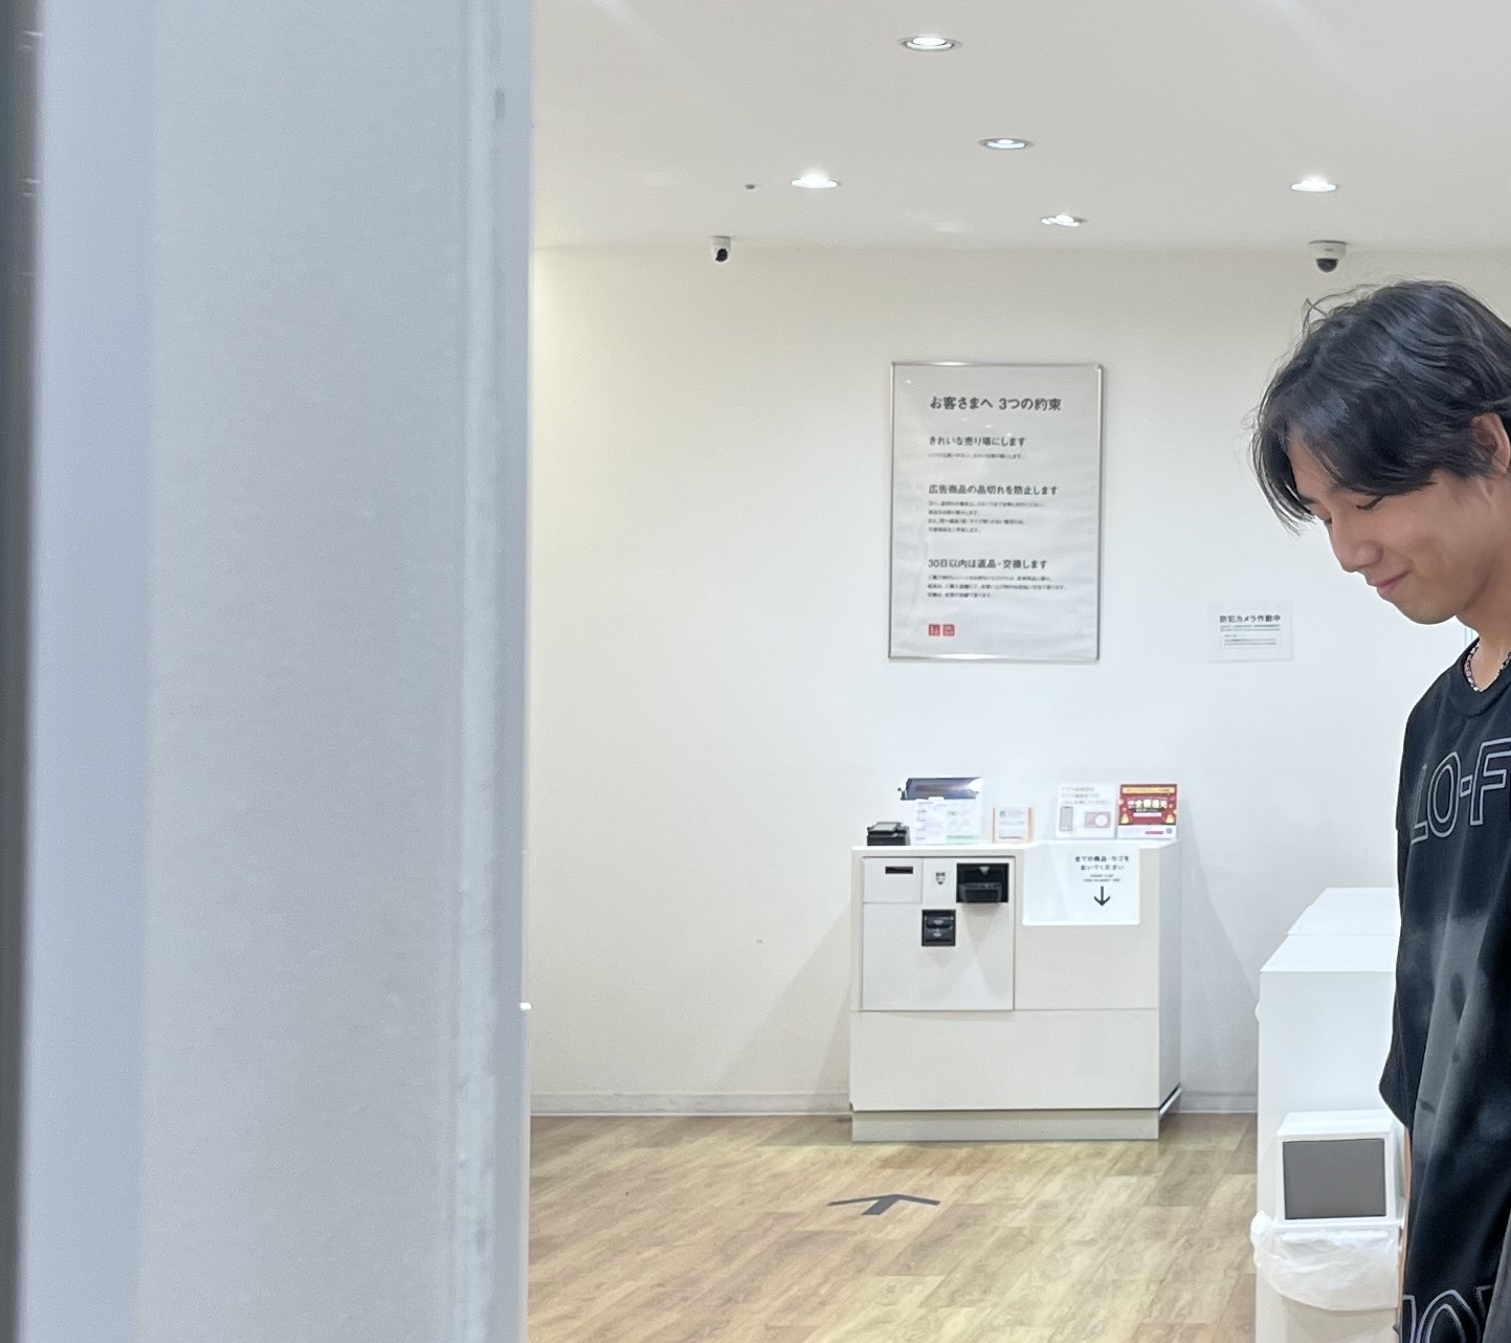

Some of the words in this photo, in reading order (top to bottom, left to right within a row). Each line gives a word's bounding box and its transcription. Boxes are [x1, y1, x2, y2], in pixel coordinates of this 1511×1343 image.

[929, 396, 993, 410] お客さまへ
[998, 397, 1061, 411] 3つの約束
[929, 436, 1026, 447] きれいな売り場にします
[928, 484, 1058, 495] 広告商品の品切れを防止します
[928, 559, 1048, 569] 30日以内は返品・交換します
